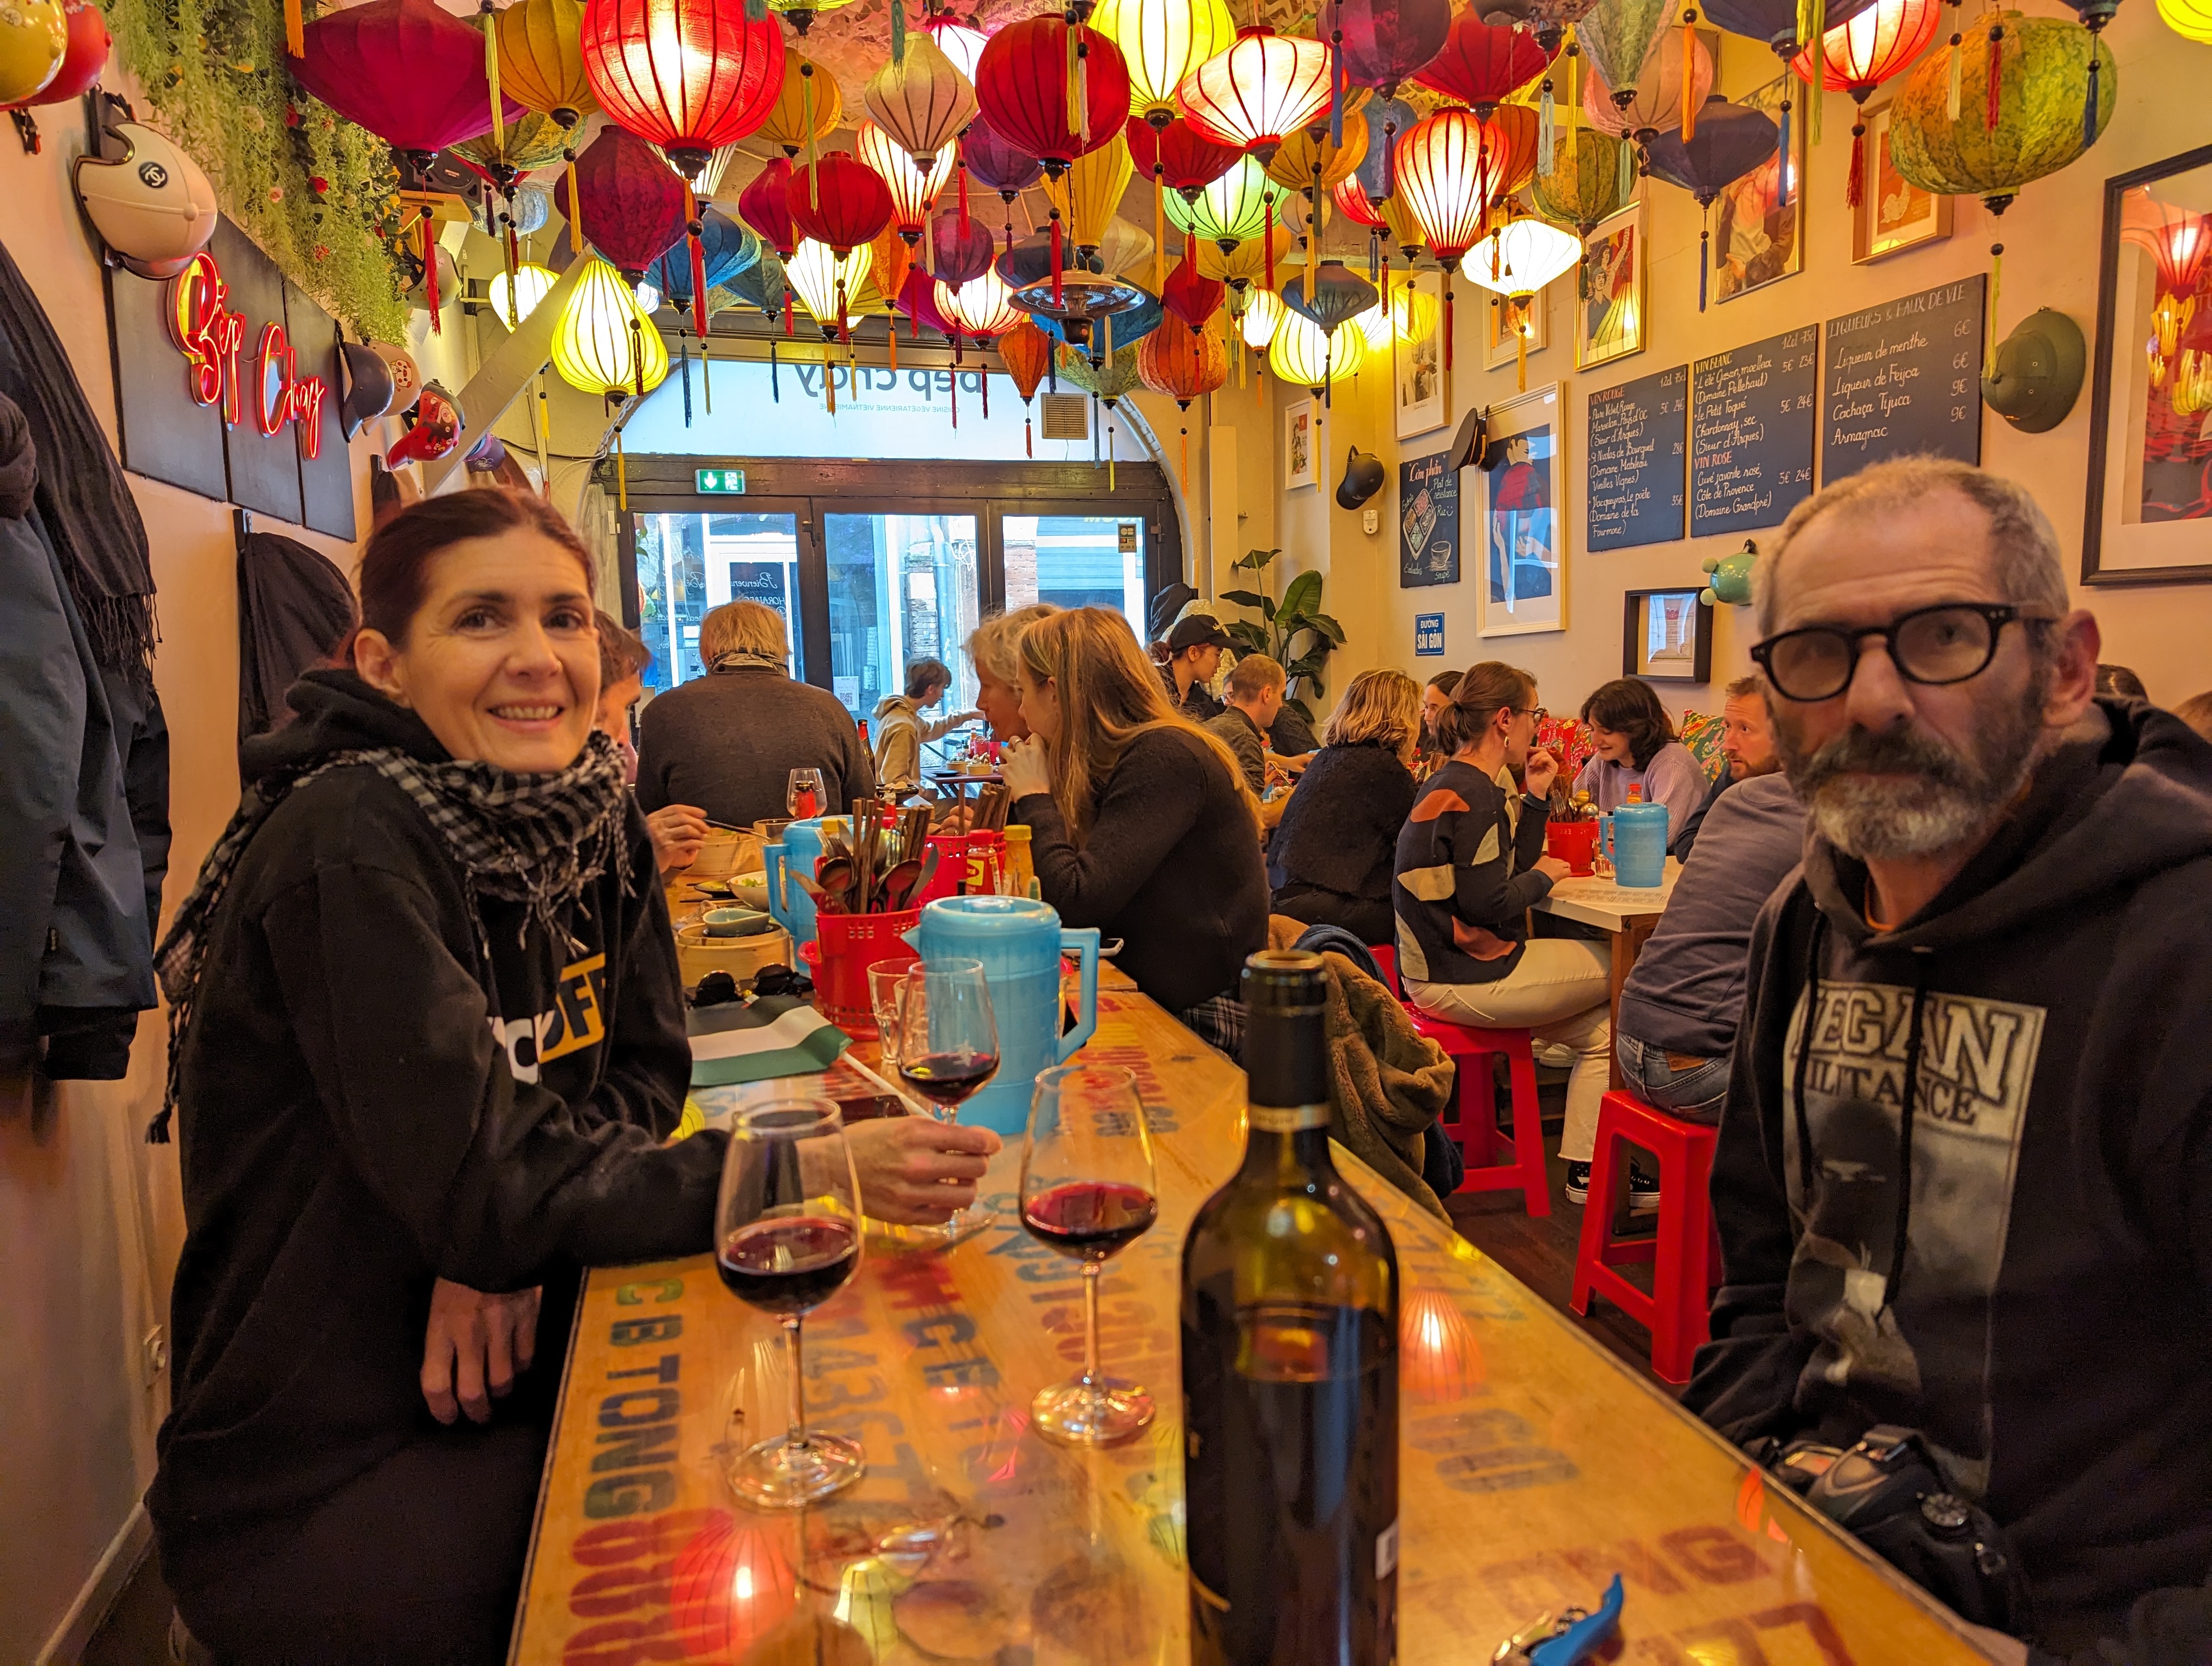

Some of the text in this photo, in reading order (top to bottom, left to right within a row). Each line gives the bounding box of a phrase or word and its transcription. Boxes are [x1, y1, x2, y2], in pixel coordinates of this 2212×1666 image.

[1828, 311, 1881, 339] LIQUEURS
[1886, 307, 1892, 322] &
[1928, 290, 1943, 310] DE
[1946, 284, 1965, 304] VIE
[1834, 319, 1971, 374] Liqueur de menthe 6€
[1696, 360, 1708, 374] VIN
[1709, 353, 1732, 370] BLANC
[1782, 359, 1793, 373] 5€
[1799, 353, 1815, 368] 23€
[1832, 351, 1969, 400] Liqueur de Feijoa 6€
[1590, 394, 1603, 406] VIN
[1603, 386, 1625, 402] ROUGE
[1695, 390, 1727, 405] (Domaine
[1832, 378, 1967, 421] Cachaça Tijuca 9€
[1697, 394, 1812, 421] Le Petit Toqué 5€ 24€
[1620, 413, 1632, 430] Pays
[1744, 416, 1756, 426] sec
[1831, 406, 1966, 451] Armagnac 9€
[1617, 443, 1624, 457] de
[1672, 442, 1684, 454] 28€
[1695, 439, 1722, 455] (Sieur
[1694, 456, 1709, 470] VIN
[1433, 474, 1452, 489] Plat de
[1697, 471, 1714, 487] Cuvé
[1778, 471, 1791, 484] 5€
[1795, 467, 1812, 482] 24€
[1627, 489, 1632, 502] Le
[1671, 494, 1683, 505] 35€
[1697, 482, 1754, 502] Côte de Provence
[1437, 505, 1446, 516] Riz
[1622, 508, 1630, 518] de
[1631, 503, 1639, 516] la
[1695, 504, 1732, 520] (Domaine
[1417, 629, 1442, 649] SÀI GÒN
[1792, 986, 2023, 1107] EGAN
[1804, 1059, 1976, 1126] ILITANCE
